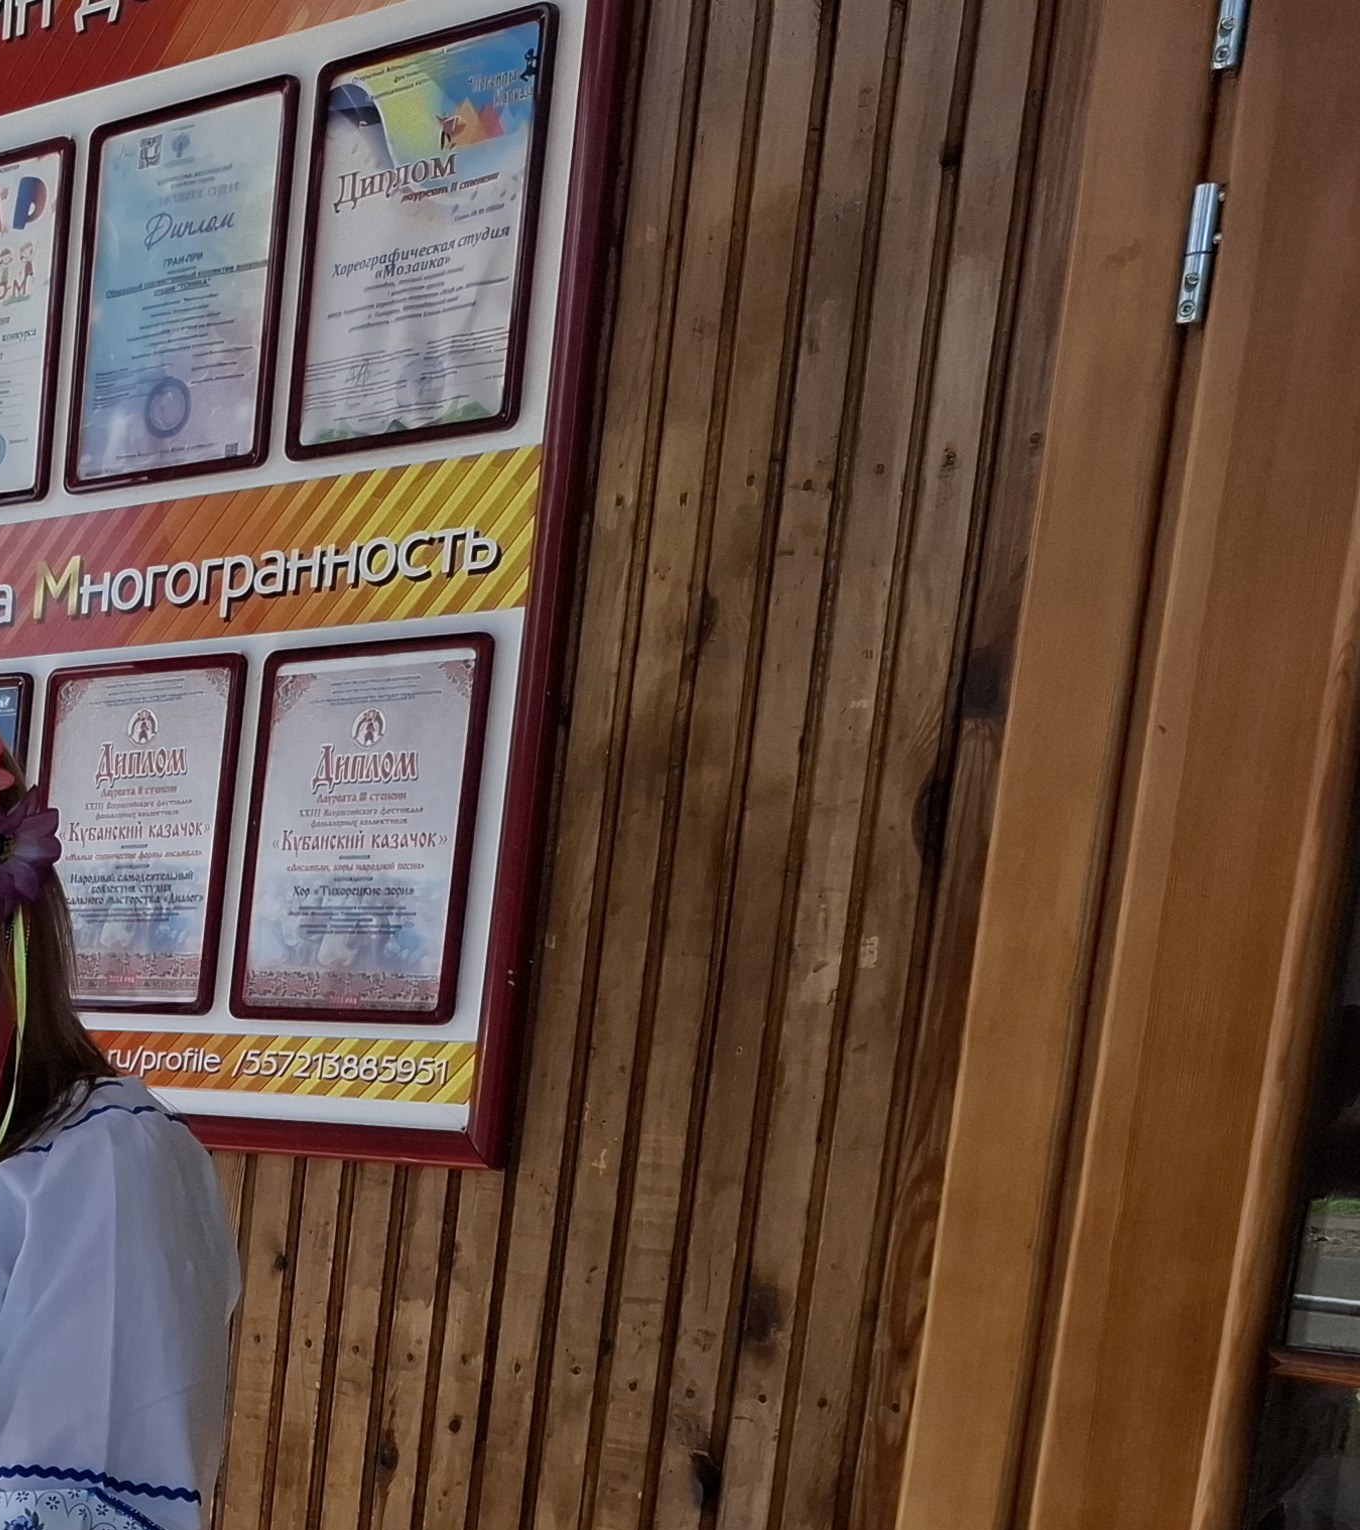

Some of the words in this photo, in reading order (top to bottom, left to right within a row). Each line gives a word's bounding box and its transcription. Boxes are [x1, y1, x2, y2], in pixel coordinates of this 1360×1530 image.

[333, 153, 457, 214] Диплом
[459, 172, 500, 191] степени
[144, 212, 235, 251] Диплом
[163, 252, 204, 267] ГРАН-ПРИ
[332, 239, 455, 278] Хореографическая
[458, 226, 511, 249] студия
[375, 256, 450, 279] «Мозаика»
[2, 328, 37, 343] конкурса
[33, 526, 501, 619] Многогранность
[95, 742, 186, 787] Диплом
[312, 744, 418, 793] Диплом
[101, 787, 135, 798] Лауреата
[145, 785, 178, 795] степени
[316, 794, 357, 804] Лауреата
[369, 792, 407, 802] степени
[323, 807, 378, 817] Всероссийского
[379, 805, 424, 815] фестиваля
[59, 821, 144, 848] «Кубанский
[148, 821, 211, 839] казачок»
[272, 830, 365, 858] «Кубанский
[371, 831, 448, 849] казачок»
[139, 851, 162, 861] формы
[333, 863, 354, 872] хоры
[355, 862, 395, 872] народной
[397, 862, 425, 871] песни»
[70, 873, 115, 885] Народный
[117, 871, 194, 883] самодеятельный
[91, 884, 136, 893] коллектив
[293, 885, 311, 898] Хор
[314, 885, 381, 898] «Тихорецкие
[384, 886, 415, 898] зори»
[163, 894, 204, 904] «Диалог»
